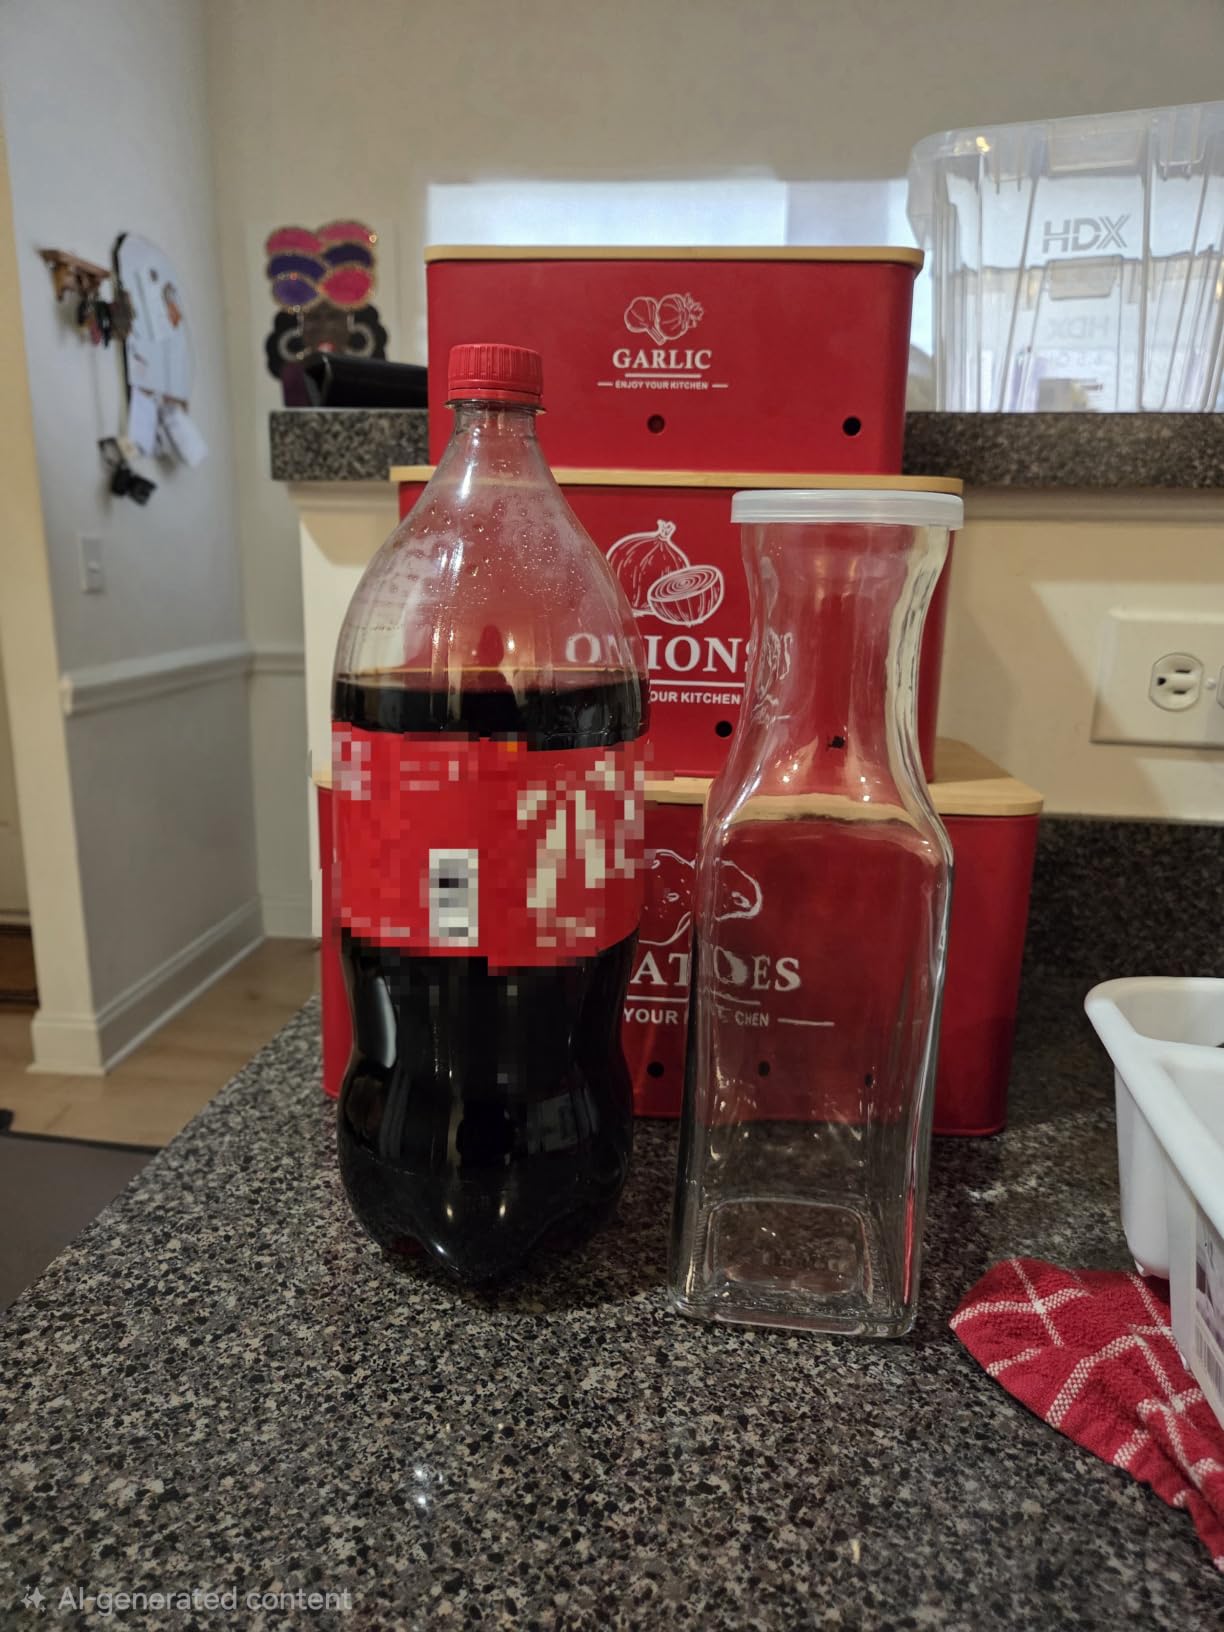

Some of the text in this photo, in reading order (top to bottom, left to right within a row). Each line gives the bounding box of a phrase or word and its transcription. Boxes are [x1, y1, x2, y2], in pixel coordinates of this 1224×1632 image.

[1042, 214, 1131, 253] HDX
[612, 348, 712, 370] GARLIC
[615, 379, 708, 390] ENJOY YOUR KITCHEN
[649, 690, 741, 705] OUR KITCHEN
[623, 1007, 679, 1024] YOUR
